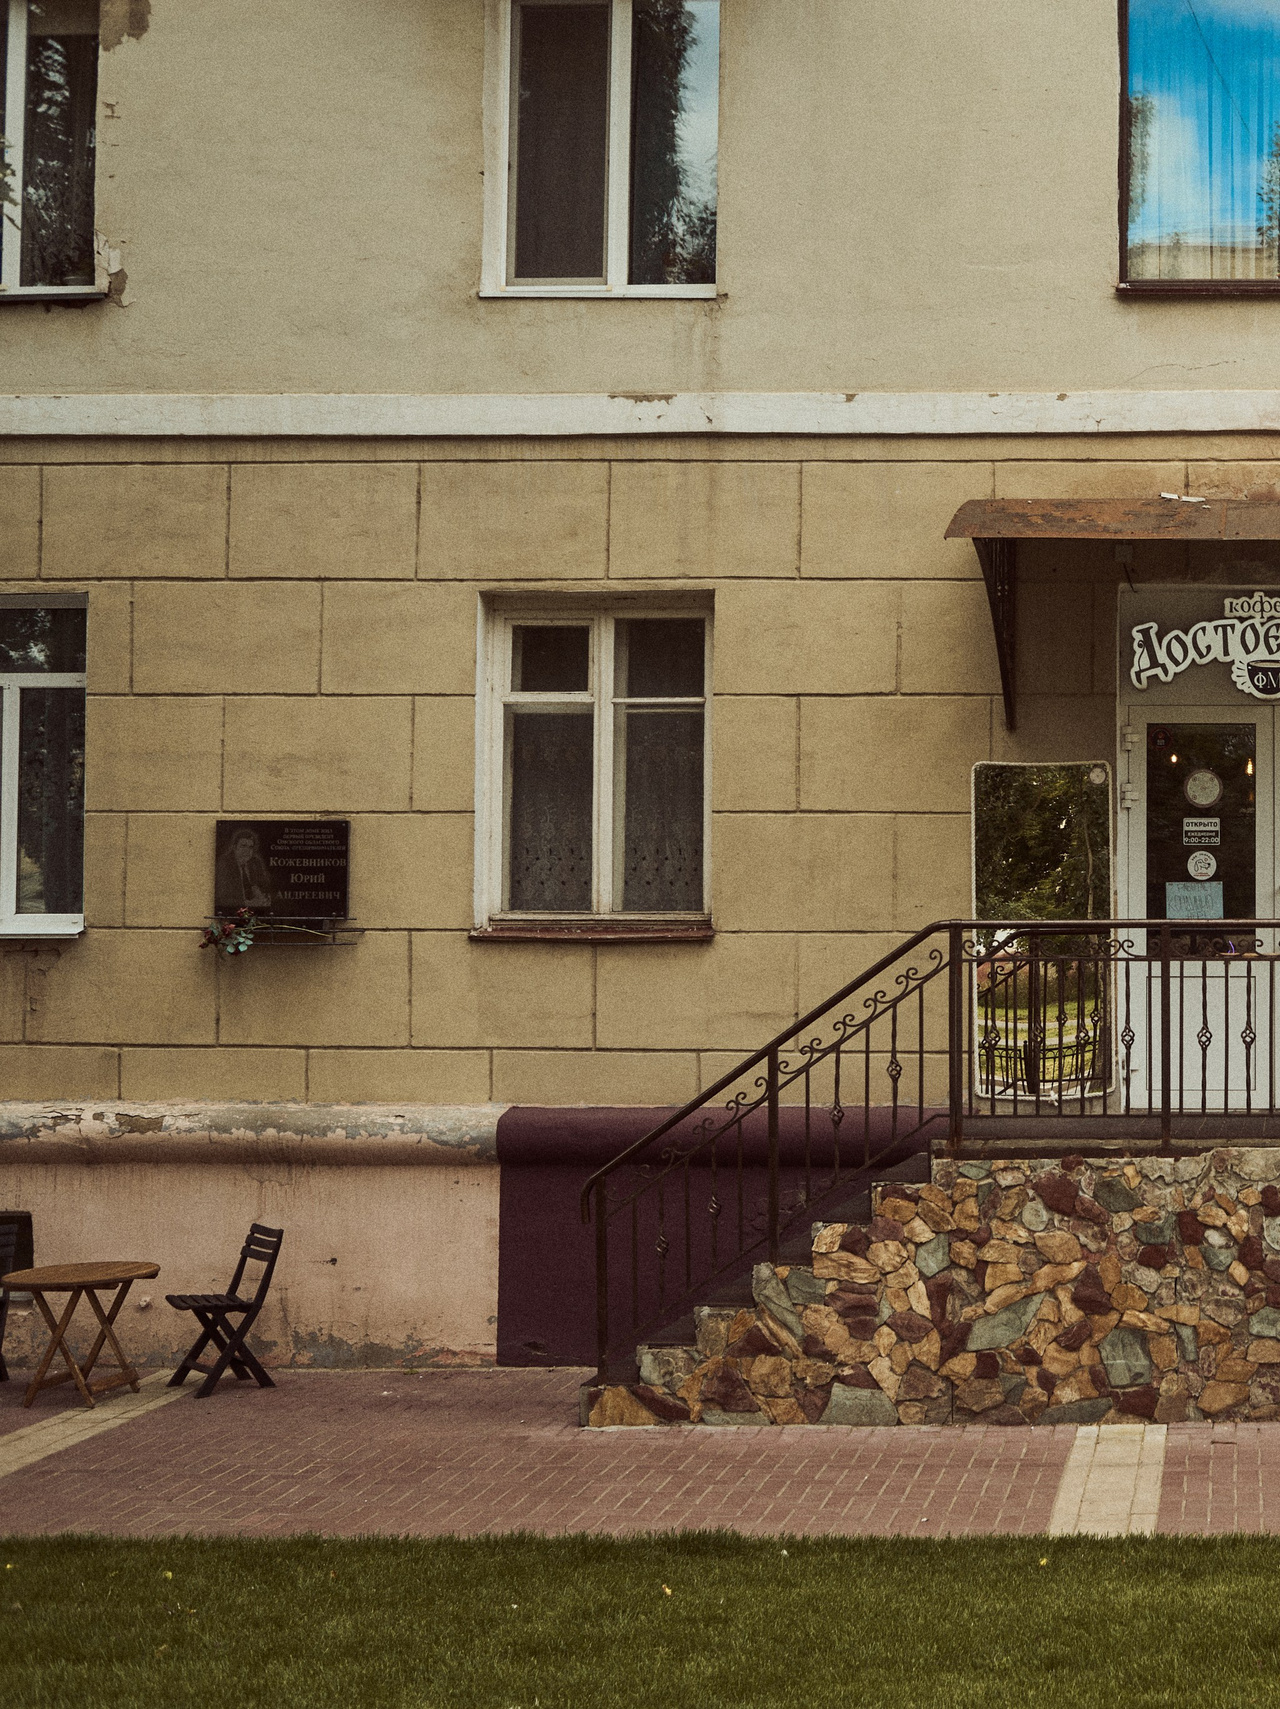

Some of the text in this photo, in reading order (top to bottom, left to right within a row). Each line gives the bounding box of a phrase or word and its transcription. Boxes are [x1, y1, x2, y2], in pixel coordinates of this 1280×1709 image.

[269, 857, 347, 867] КОЖЕВНИКОВ
[290, 873, 325, 883] ЮРИЙ
[277, 891, 340, 900] АНДРЕЕВИЧ
